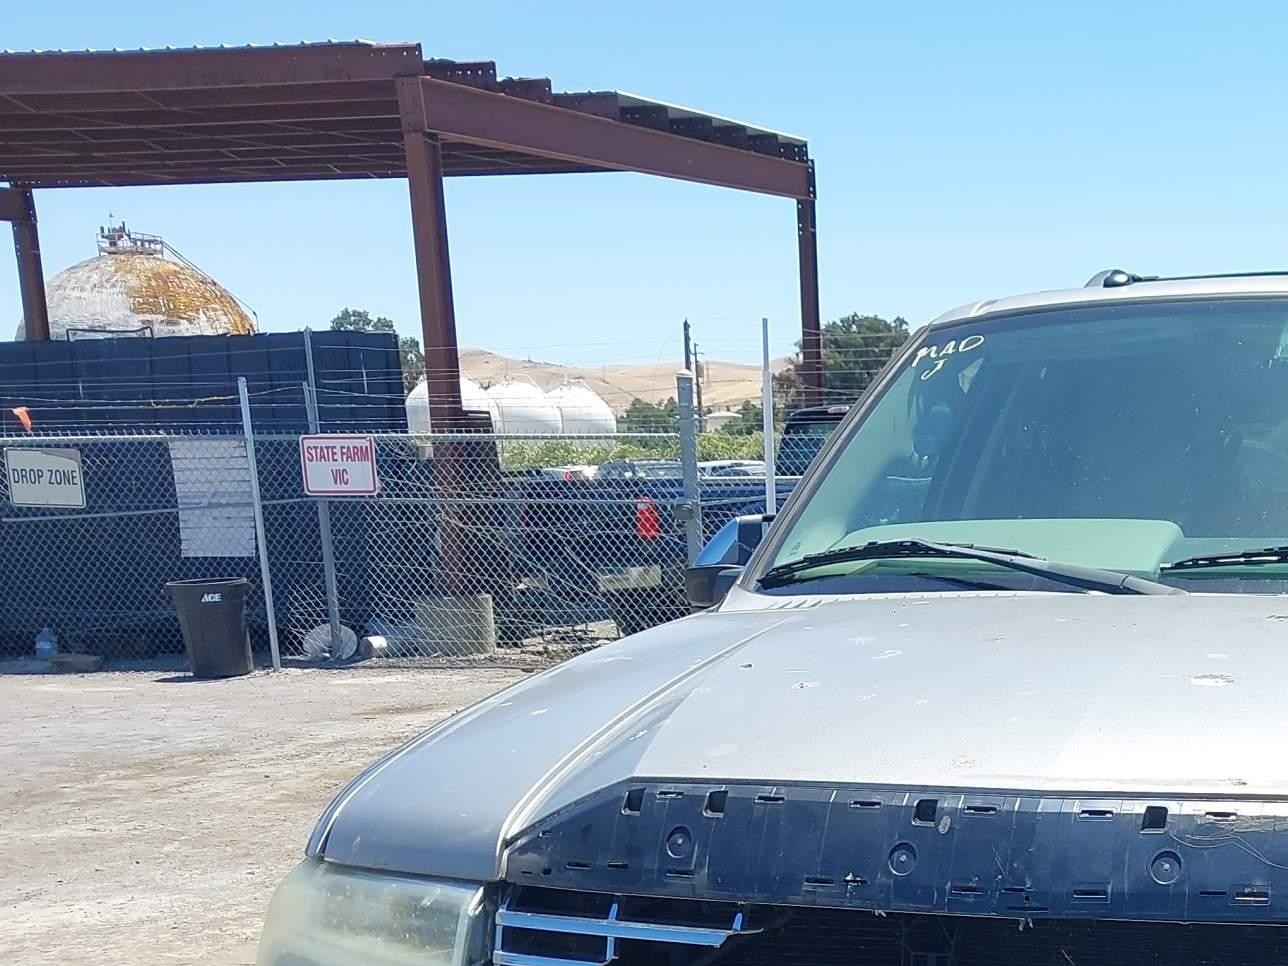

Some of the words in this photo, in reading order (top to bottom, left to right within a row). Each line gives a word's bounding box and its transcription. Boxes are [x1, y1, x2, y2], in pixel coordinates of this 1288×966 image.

[306, 445, 338, 462] STATE
[340, 445, 370, 462] FARM
[12, 468, 44, 485] DROP
[47, 469, 79, 486] ZONE
[330, 468, 349, 486] VIC
[200, 592, 223, 603] ACE
